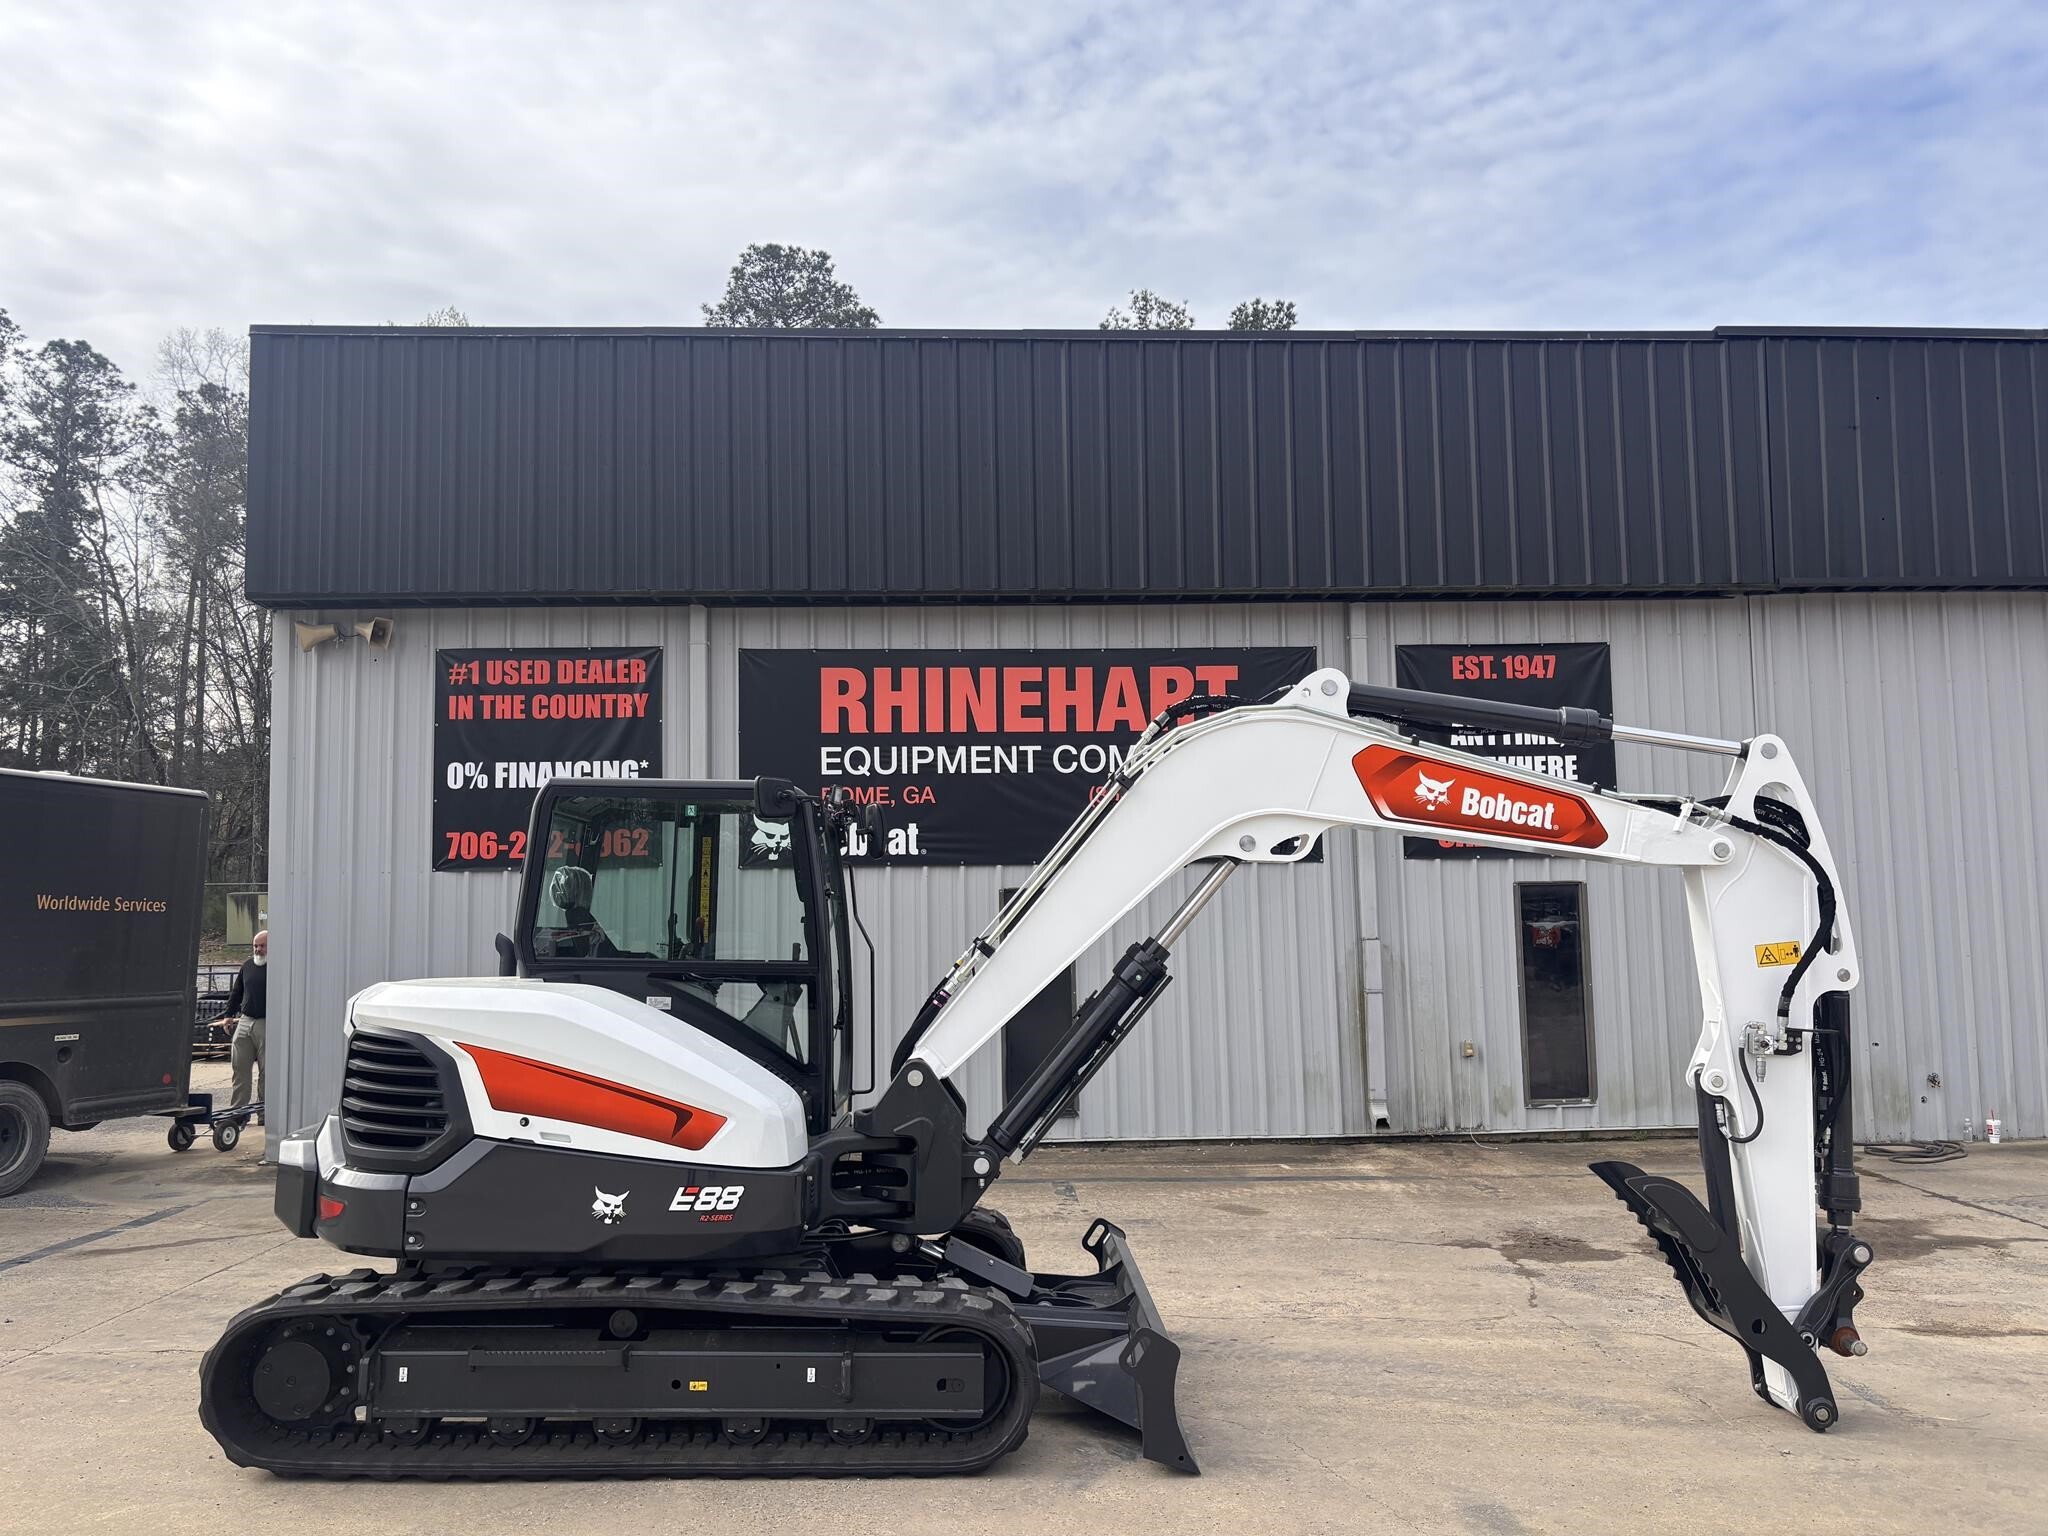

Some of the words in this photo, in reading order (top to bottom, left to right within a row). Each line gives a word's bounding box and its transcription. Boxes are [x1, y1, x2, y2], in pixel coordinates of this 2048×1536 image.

[449, 661, 480, 685] #1
[486, 660, 551, 685] USED
[557, 659, 646, 684] DEALER
[1452, 655, 1497, 680] EST.
[1502, 654, 1556, 679] 1947
[449, 695, 473, 719] IN
[479, 695, 525, 719] THE
[532, 693, 649, 719] COUNTRY
[820, 666, 1239, 733] RHINEHART
[820, 745, 1042, 776] EQUIPMENT
[447, 762, 488, 789] 0%
[903, 786, 936, 804] GA
[1461, 787, 1555, 830] Bobcat
[37, 894, 111, 911] Worldwide
[114, 897, 167, 912] Services
[668, 1186, 745, 1211] E88
[700, 1214, 733, 1222] R2-SERIES
